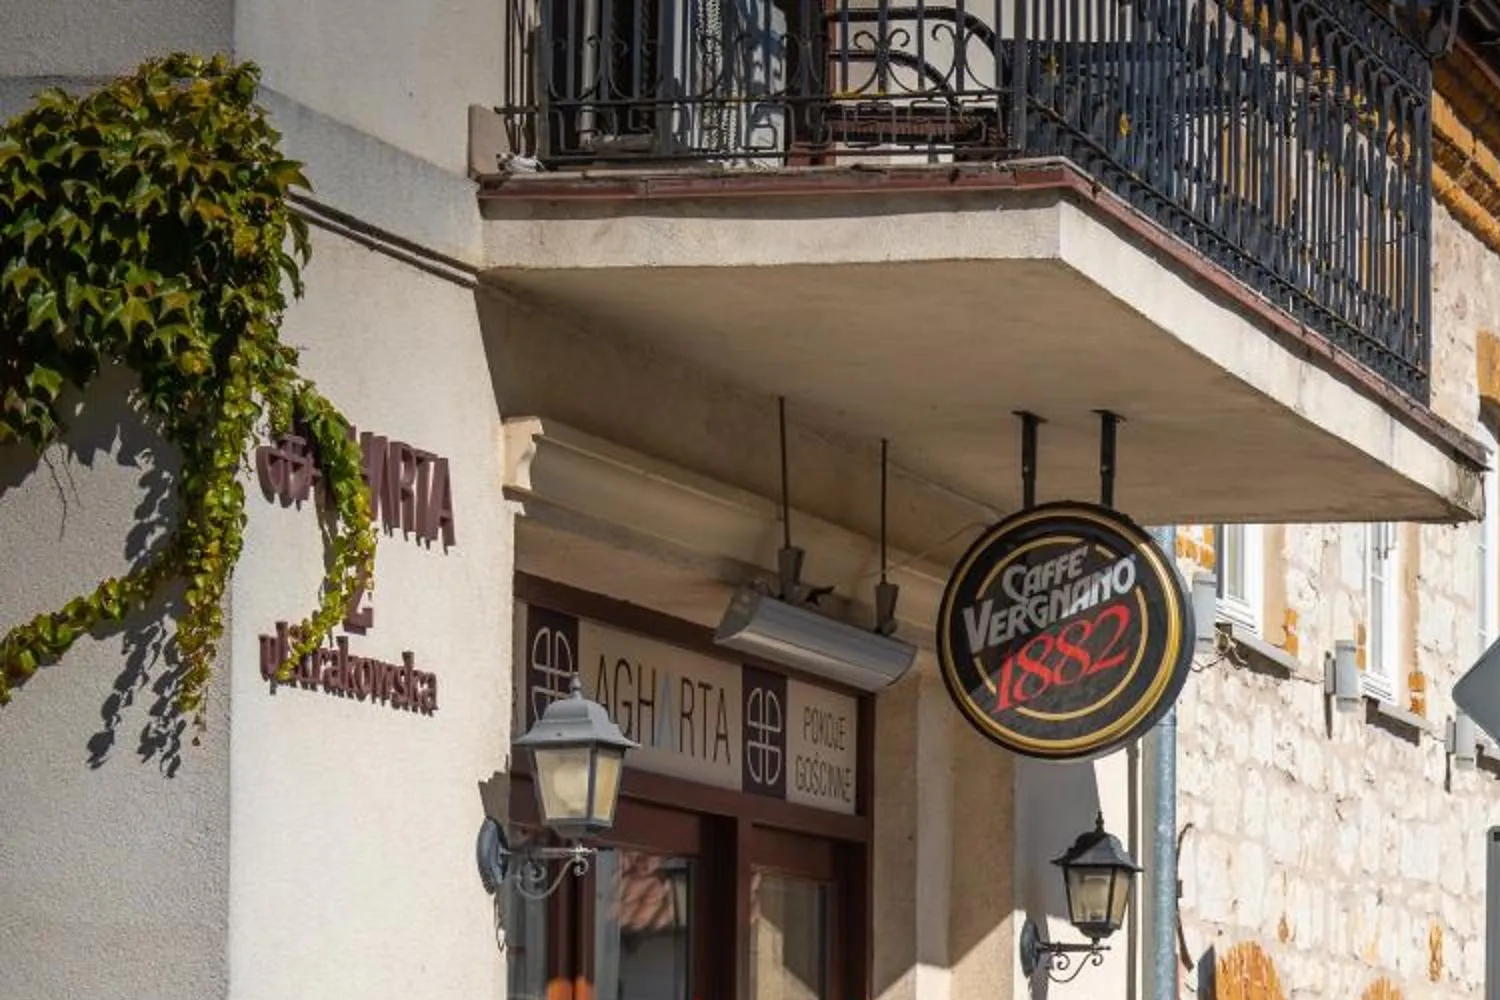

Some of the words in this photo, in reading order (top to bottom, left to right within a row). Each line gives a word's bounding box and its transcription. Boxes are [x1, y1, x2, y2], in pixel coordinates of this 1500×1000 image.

[963, 556, 1136, 654] VERGNANO
[992, 602, 1131, 714] 1882
[595, 654, 732, 765] AGHARTA
